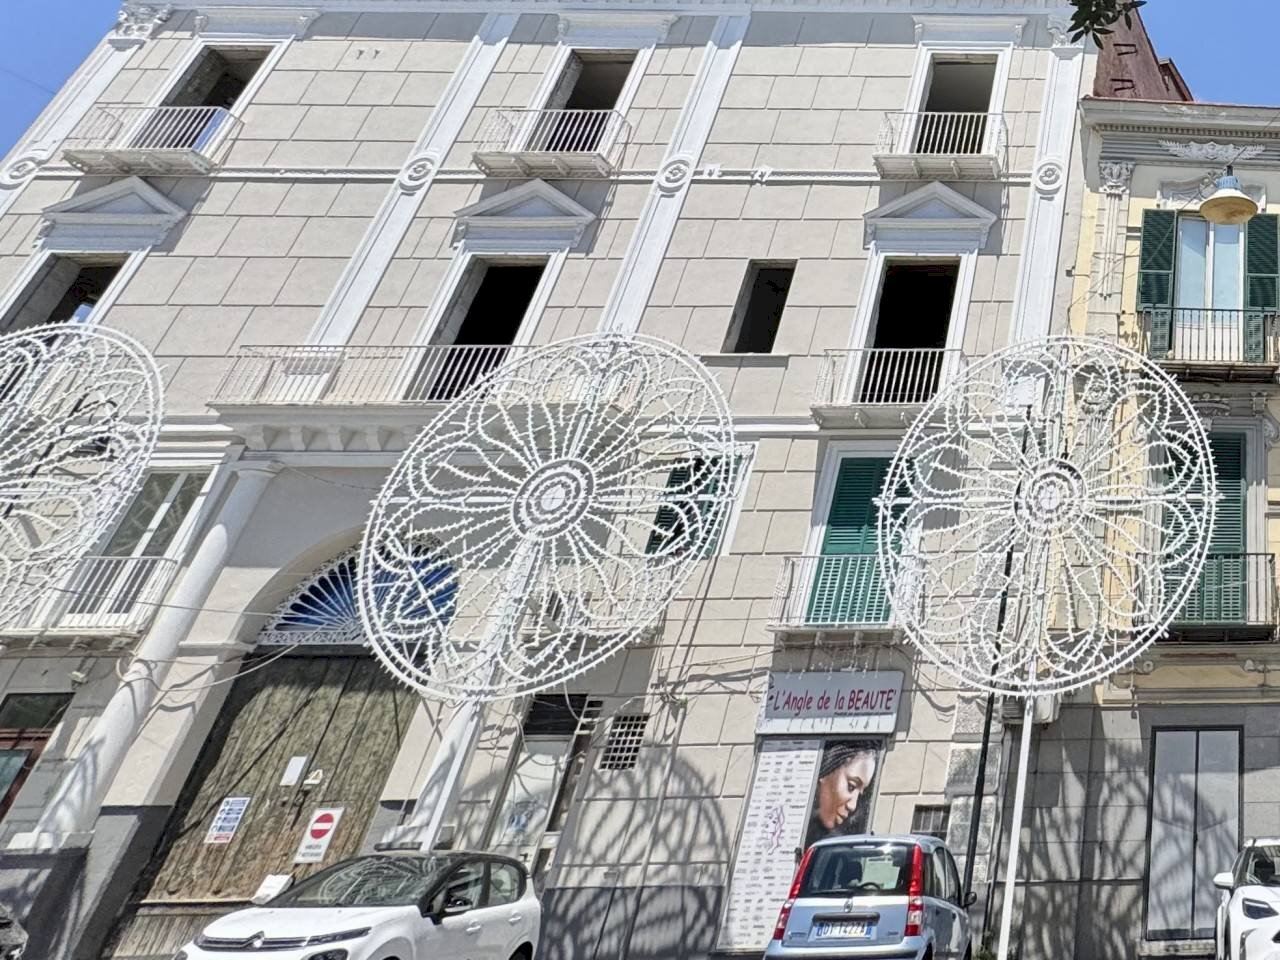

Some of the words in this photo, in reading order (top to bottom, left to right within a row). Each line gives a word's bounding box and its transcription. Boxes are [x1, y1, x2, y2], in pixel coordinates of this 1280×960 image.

[773, 689, 813, 716] L'Angle
[817, 690, 831, 710] de
[834, 689, 845, 710] la
